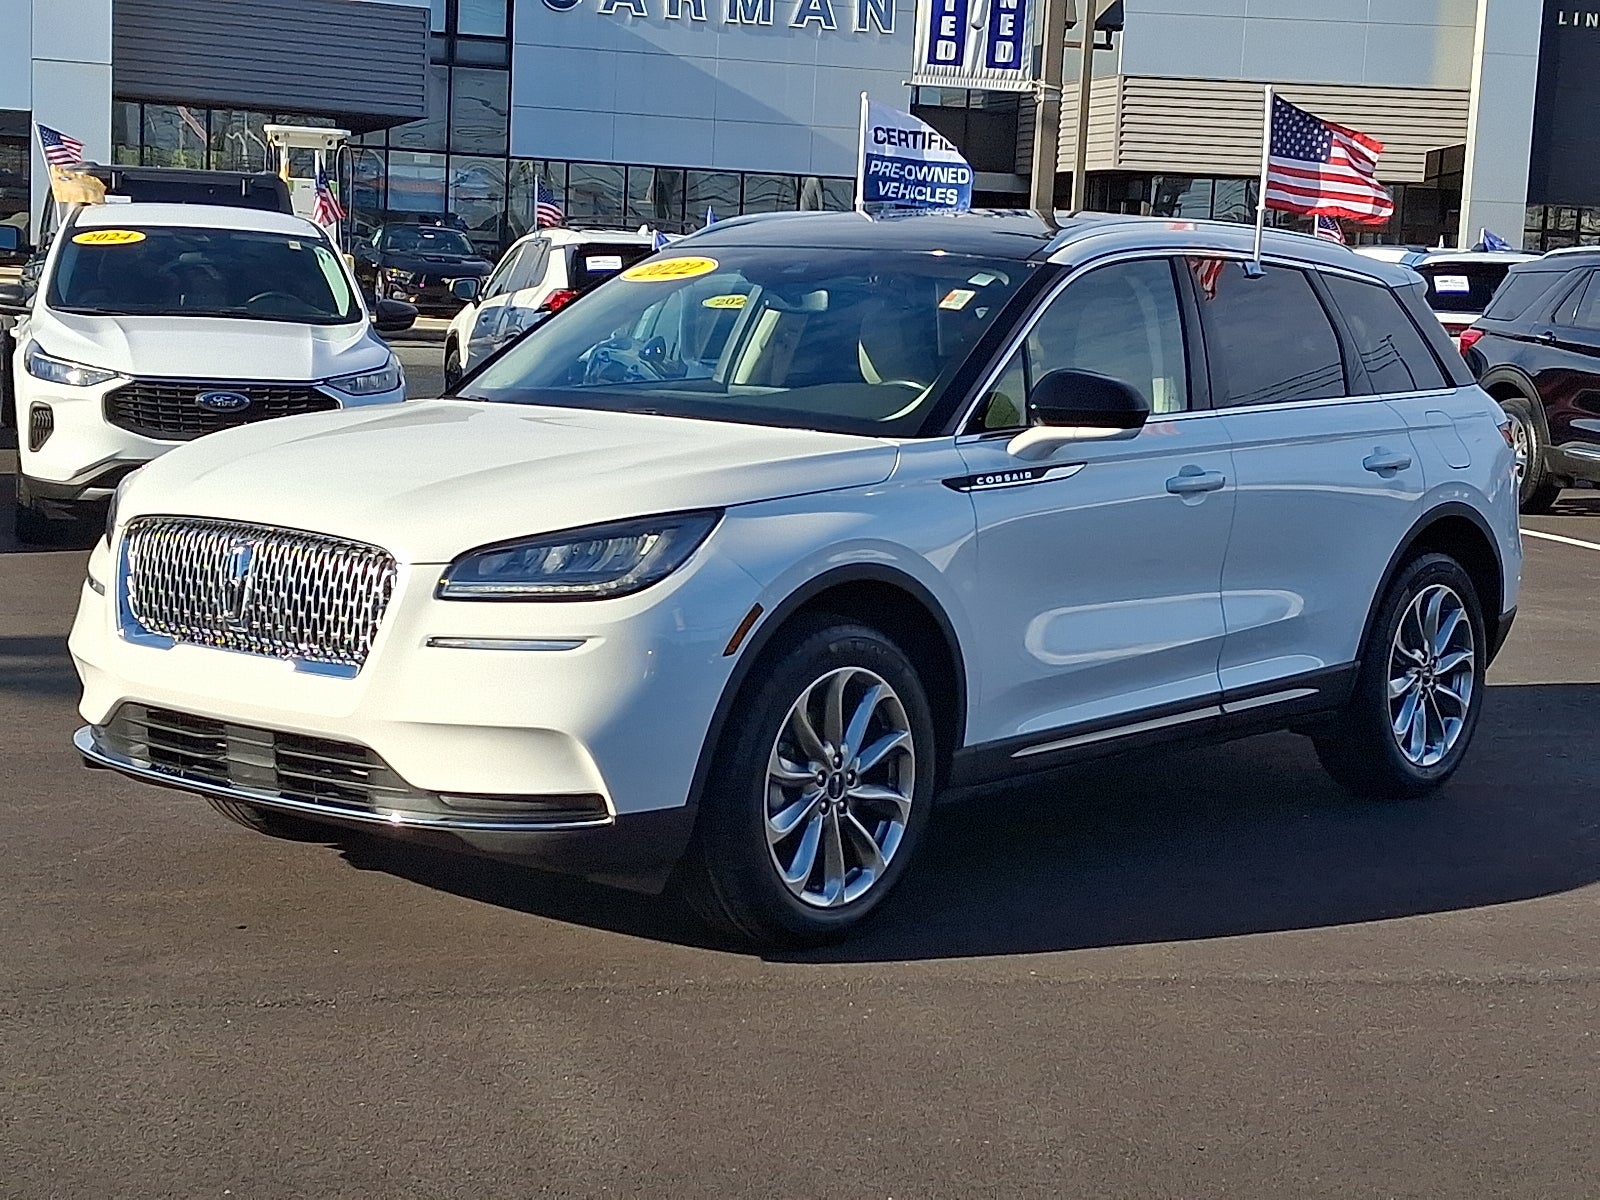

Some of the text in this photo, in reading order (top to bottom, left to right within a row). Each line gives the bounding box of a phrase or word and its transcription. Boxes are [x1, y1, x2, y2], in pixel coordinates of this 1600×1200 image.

[1558, 10, 1598, 28] LIN
[869, 160, 970, 185] PRE-OWNED
[878, 180, 958, 205] VEHICLES
[84, 232, 134, 242] 2024
[631, 261, 705, 277] 2022
[976, 471, 1032, 485] CORSAIR
